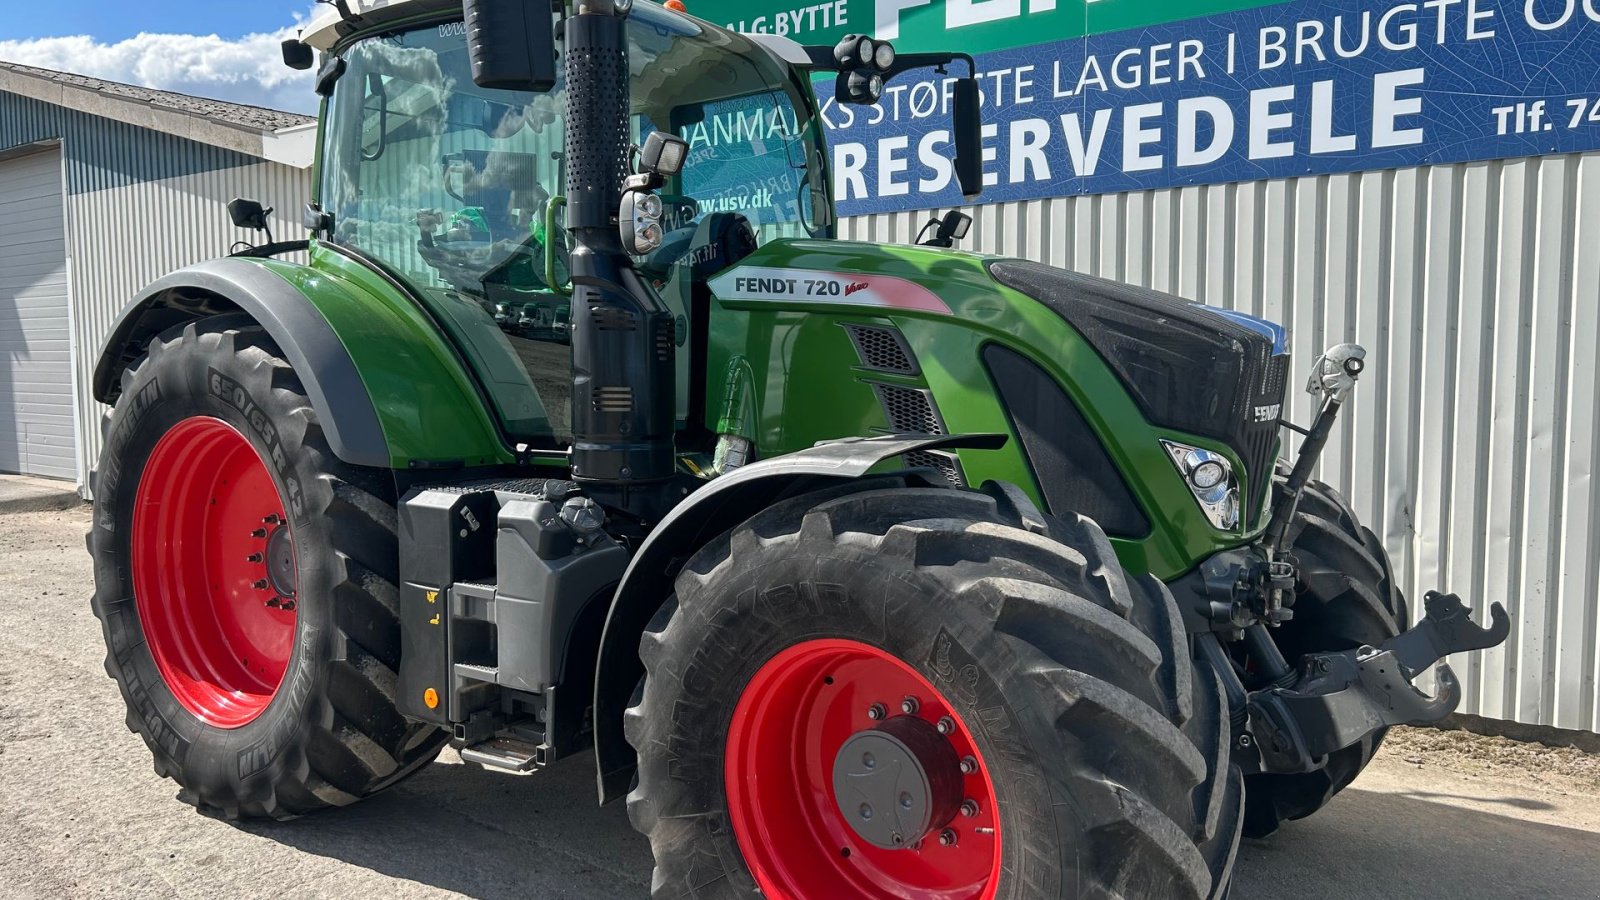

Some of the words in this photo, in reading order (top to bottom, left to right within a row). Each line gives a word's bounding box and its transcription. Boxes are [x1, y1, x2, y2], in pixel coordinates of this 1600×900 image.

[868, 65, 1035, 126] STØTE
[1053, 38, 1206, 98] LAGER
[1227, 33, 1235, 74] I
[1258, 0, 1495, 70] BRUGTE
[834, 67, 1425, 201] RESERVEDELE
[1491, 100, 1552, 136] Tlf.
[697, 187, 773, 214] w.usv.dk
[735, 277, 797, 294] FENDT
[804, 279, 840, 296] 720
[211, 373, 275, 446] 650/65
[272, 442, 286, 473] R
